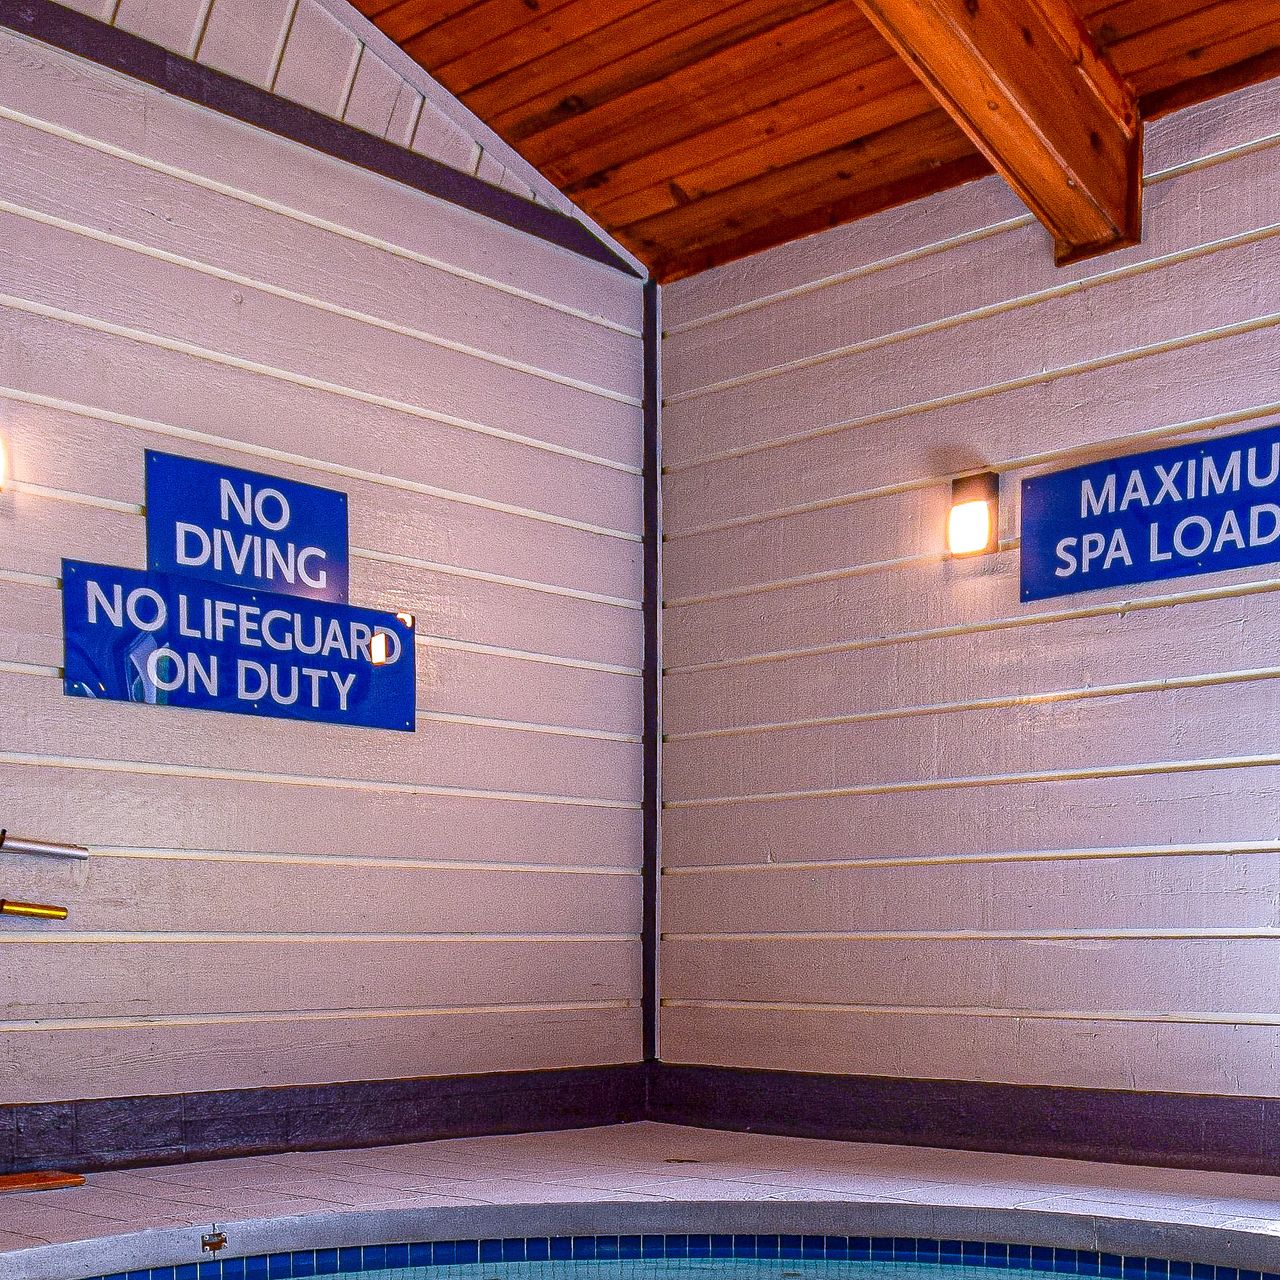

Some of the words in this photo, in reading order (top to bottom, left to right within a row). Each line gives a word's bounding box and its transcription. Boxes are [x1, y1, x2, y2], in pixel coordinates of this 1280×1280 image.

[220, 478, 290, 531] NO
[176, 522, 326, 588] DIVING
[1055, 528, 1132, 577] SPA
[87, 581, 167, 631] NO
[179, 594, 401, 665] LIFEGUARD
[146, 648, 218, 697] ON
[237, 660, 356, 711] DUTY
